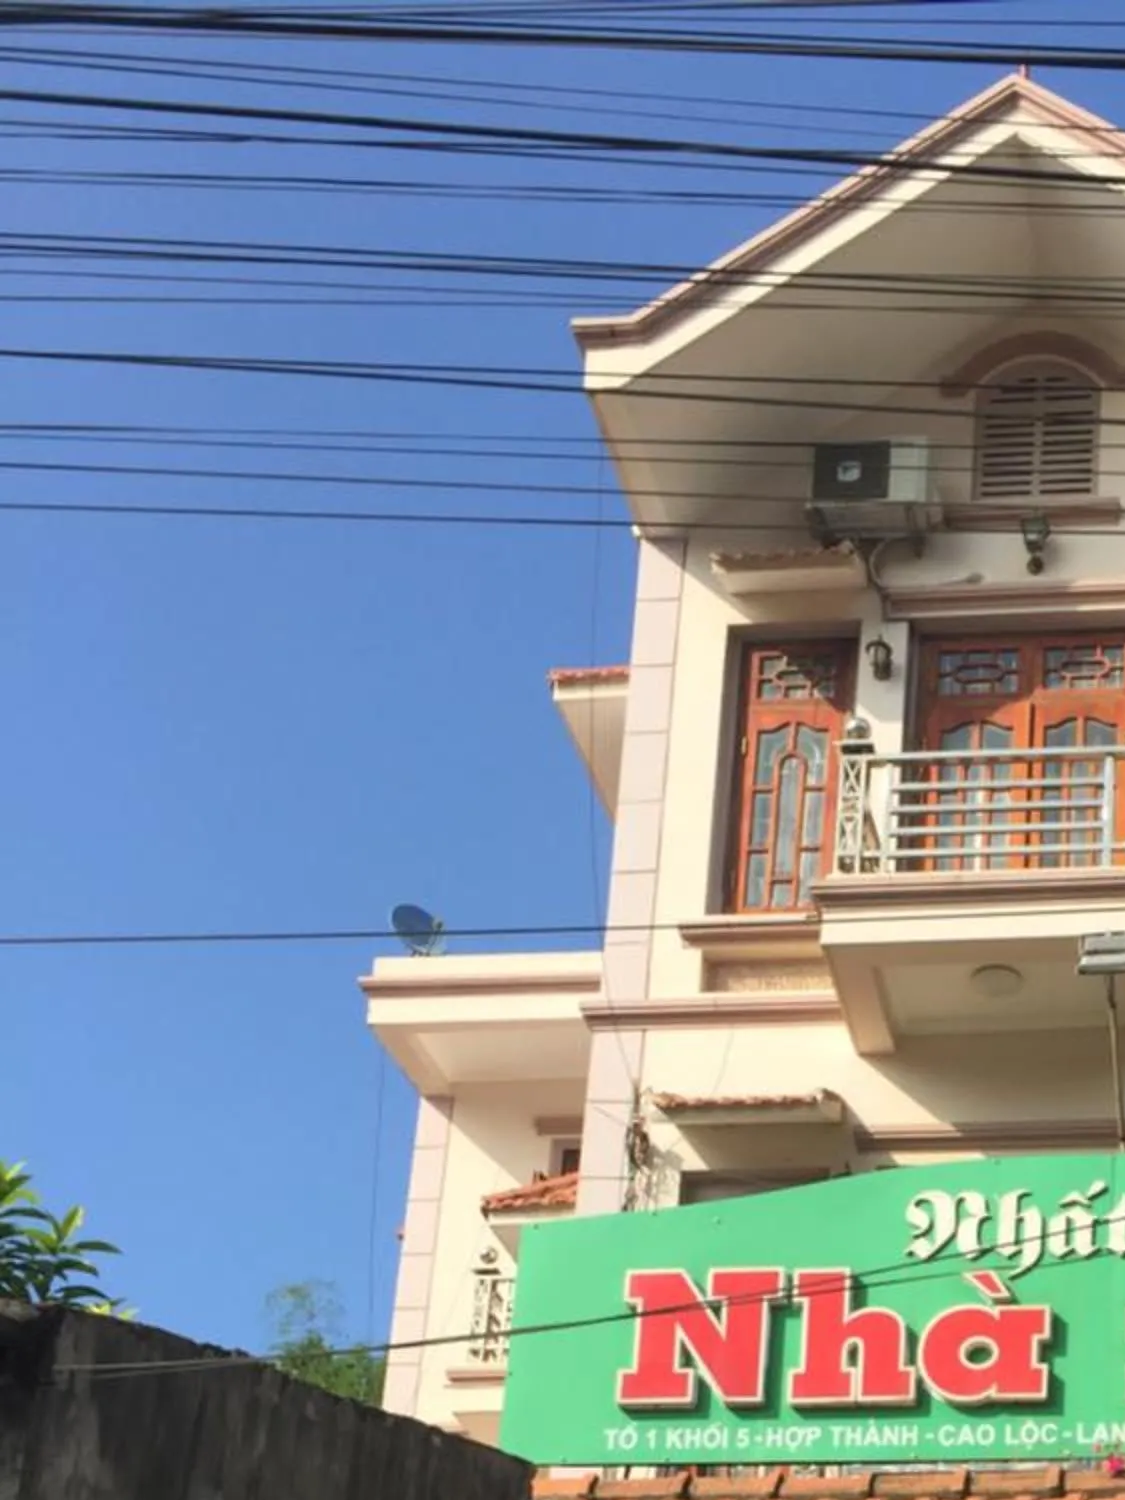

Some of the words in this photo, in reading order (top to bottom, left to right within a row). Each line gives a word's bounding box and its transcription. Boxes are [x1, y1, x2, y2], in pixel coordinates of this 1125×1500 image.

[616, 1268, 1052, 1408] Nhà
[646, 1429, 657, 1449] 1
[665, 1422, 728, 1449] KHỐI
[829, 1417, 919, 1448] THÀNH
